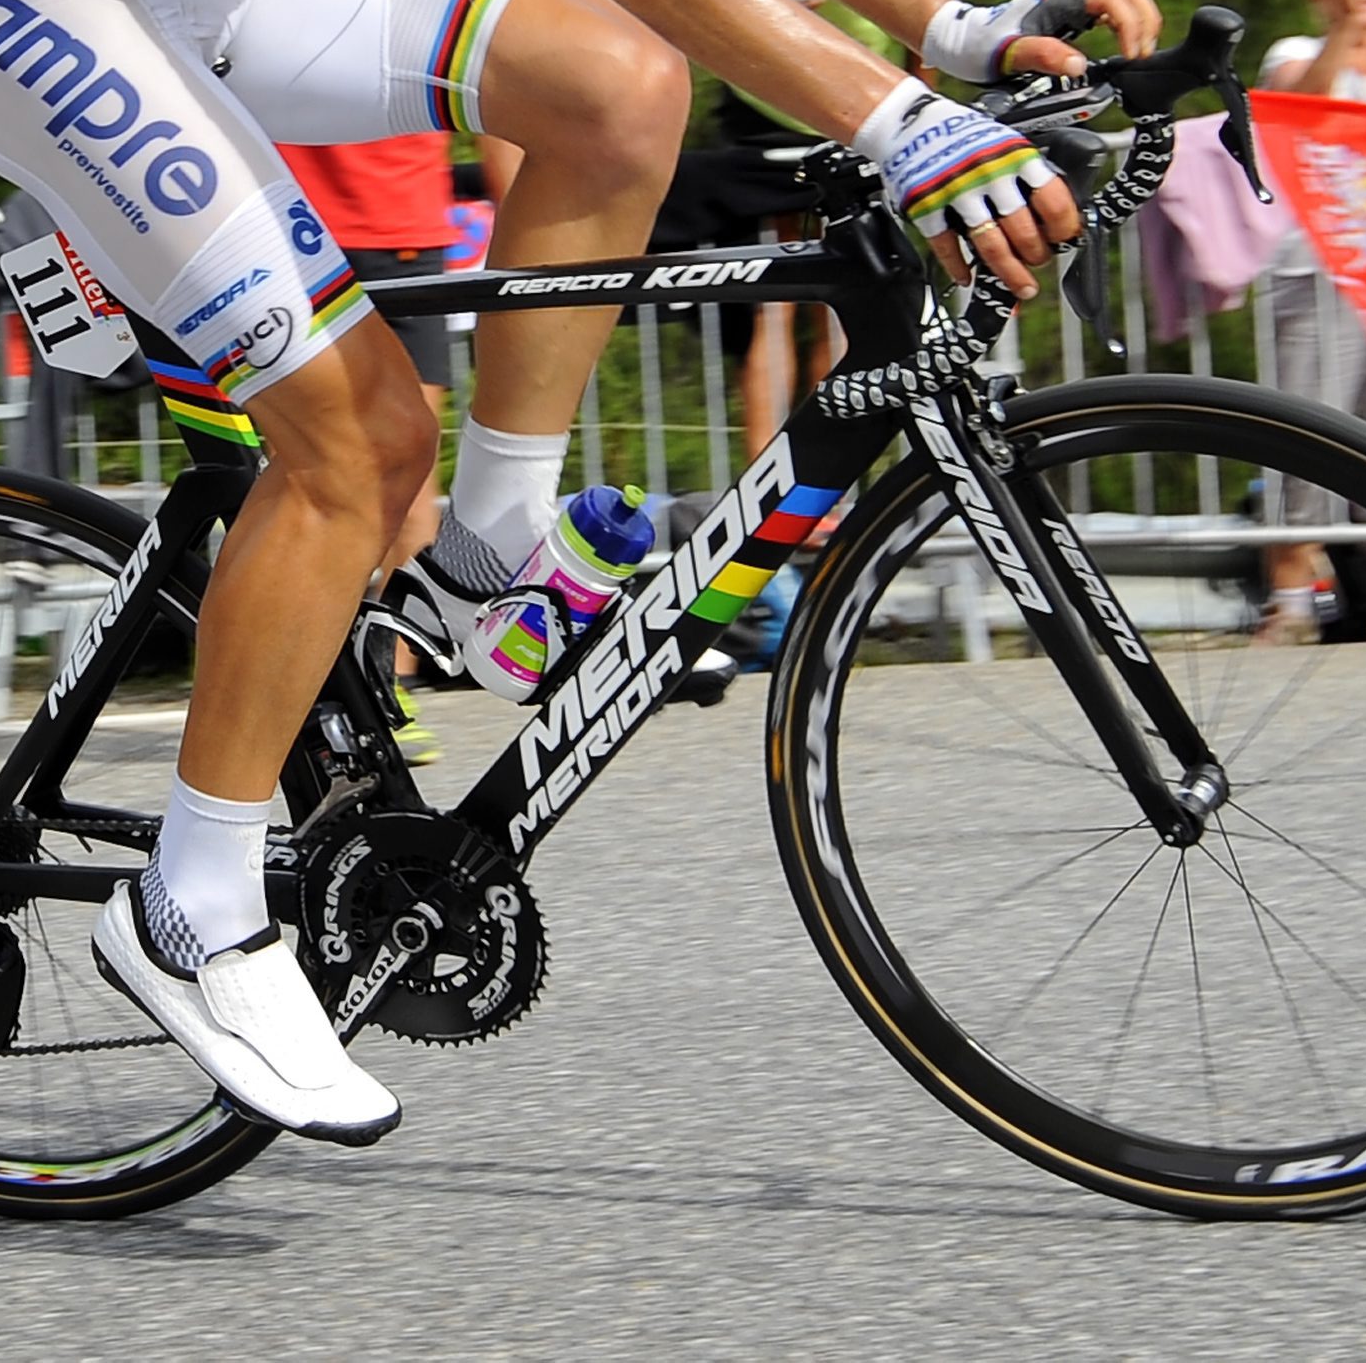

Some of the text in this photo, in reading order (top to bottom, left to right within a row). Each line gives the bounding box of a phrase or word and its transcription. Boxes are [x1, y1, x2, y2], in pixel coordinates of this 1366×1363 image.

[57, 137, 151, 235] prerivestite
[10, 257, 92, 355] 111
[237, 312, 284, 351] UCI
[497, 258, 774, 297] REACTO KOM
[910, 396, 1054, 615] MERIDA
[46, 517, 163, 720] MERIDA
[519, 431, 796, 791] MERIDA
[1042, 517, 1150, 665] REACTO
[508, 635, 684, 854] MERIDA
[336, 951, 395, 1022] ROTOR
